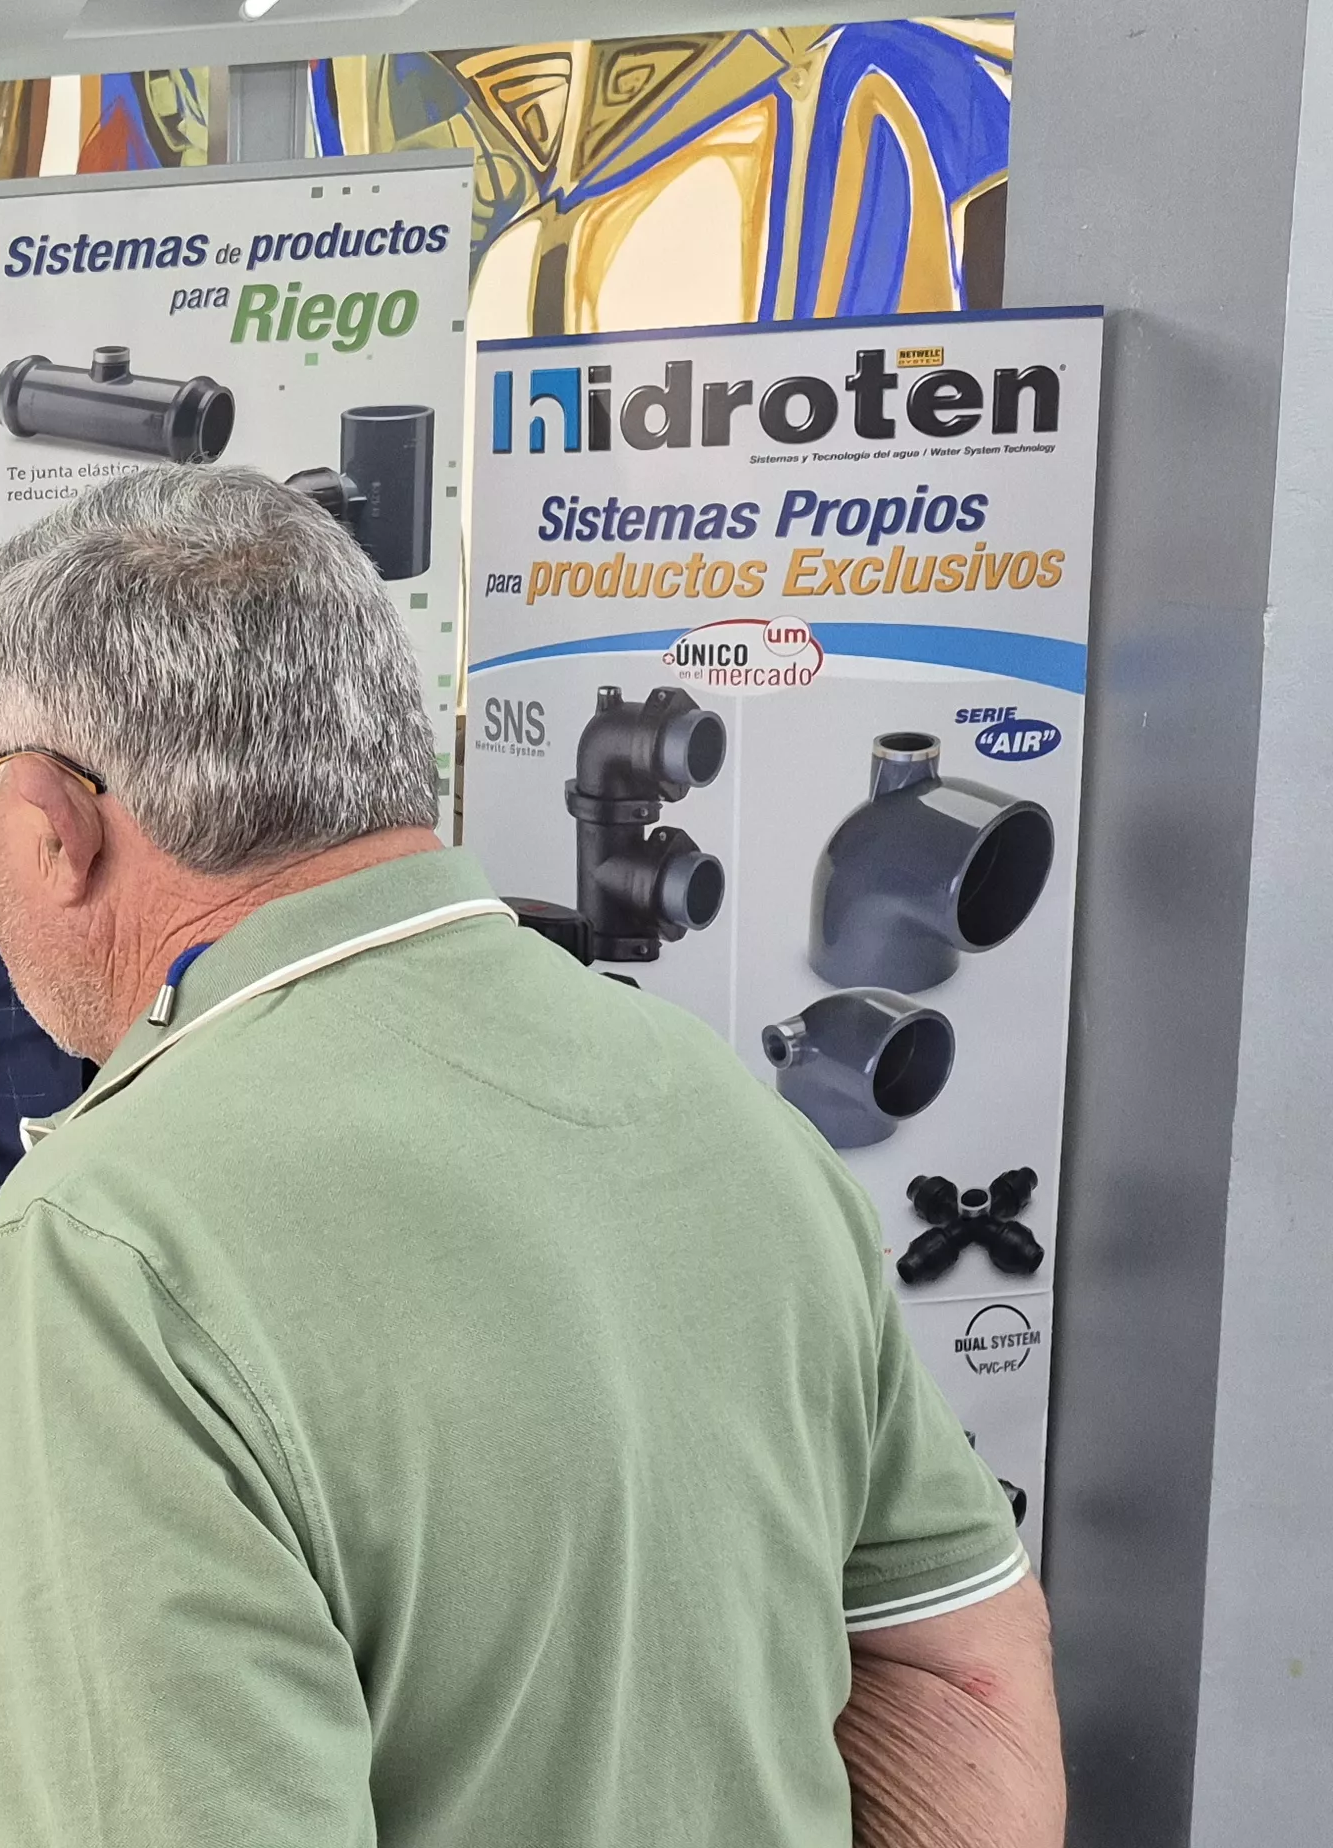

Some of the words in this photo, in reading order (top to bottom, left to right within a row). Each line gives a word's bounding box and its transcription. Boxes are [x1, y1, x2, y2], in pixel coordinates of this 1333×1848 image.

[4, 232, 208, 279] Sistemas
[216, 243, 241, 266] de
[246, 219, 449, 270] productos
[170, 284, 229, 315] para
[230, 281, 419, 353] Riego
[749, 454, 799, 464] Sistemas
[801, 456, 808, 464] y
[873, 451, 890, 460] del
[893, 451, 919, 460] agua
[930, 447, 961, 456] Water
[964, 445, 1001, 456] System
[1003, 444, 1056, 454] Technology
[7, 467, 26, 480] Te
[31, 465, 73, 483] junta
[7, 486, 78, 501] reducida
[538, 495, 761, 542] Sistemas
[775, 484, 989, 546] Propios
[485, 573, 522, 598] para
[526, 552, 768, 606] productos
[782, 542, 1065, 597] Exclusivos
[767, 628, 806, 643] um
[676, 638, 748, 667] ÚNICO
[679, 671, 691, 679] en
[694, 669, 703, 679] el
[708, 662, 812, 686] mercado
[484, 697, 545, 747] SNS
[955, 706, 1017, 724] SERIE
[509, 744, 545, 757] System
[979, 729, 1056, 754] “AIR”
[954, 1336, 988, 1353] DUAL
[990, 1330, 1041, 1350] SYSTEM
[978, 1359, 1018, 1375] PVC-PE
